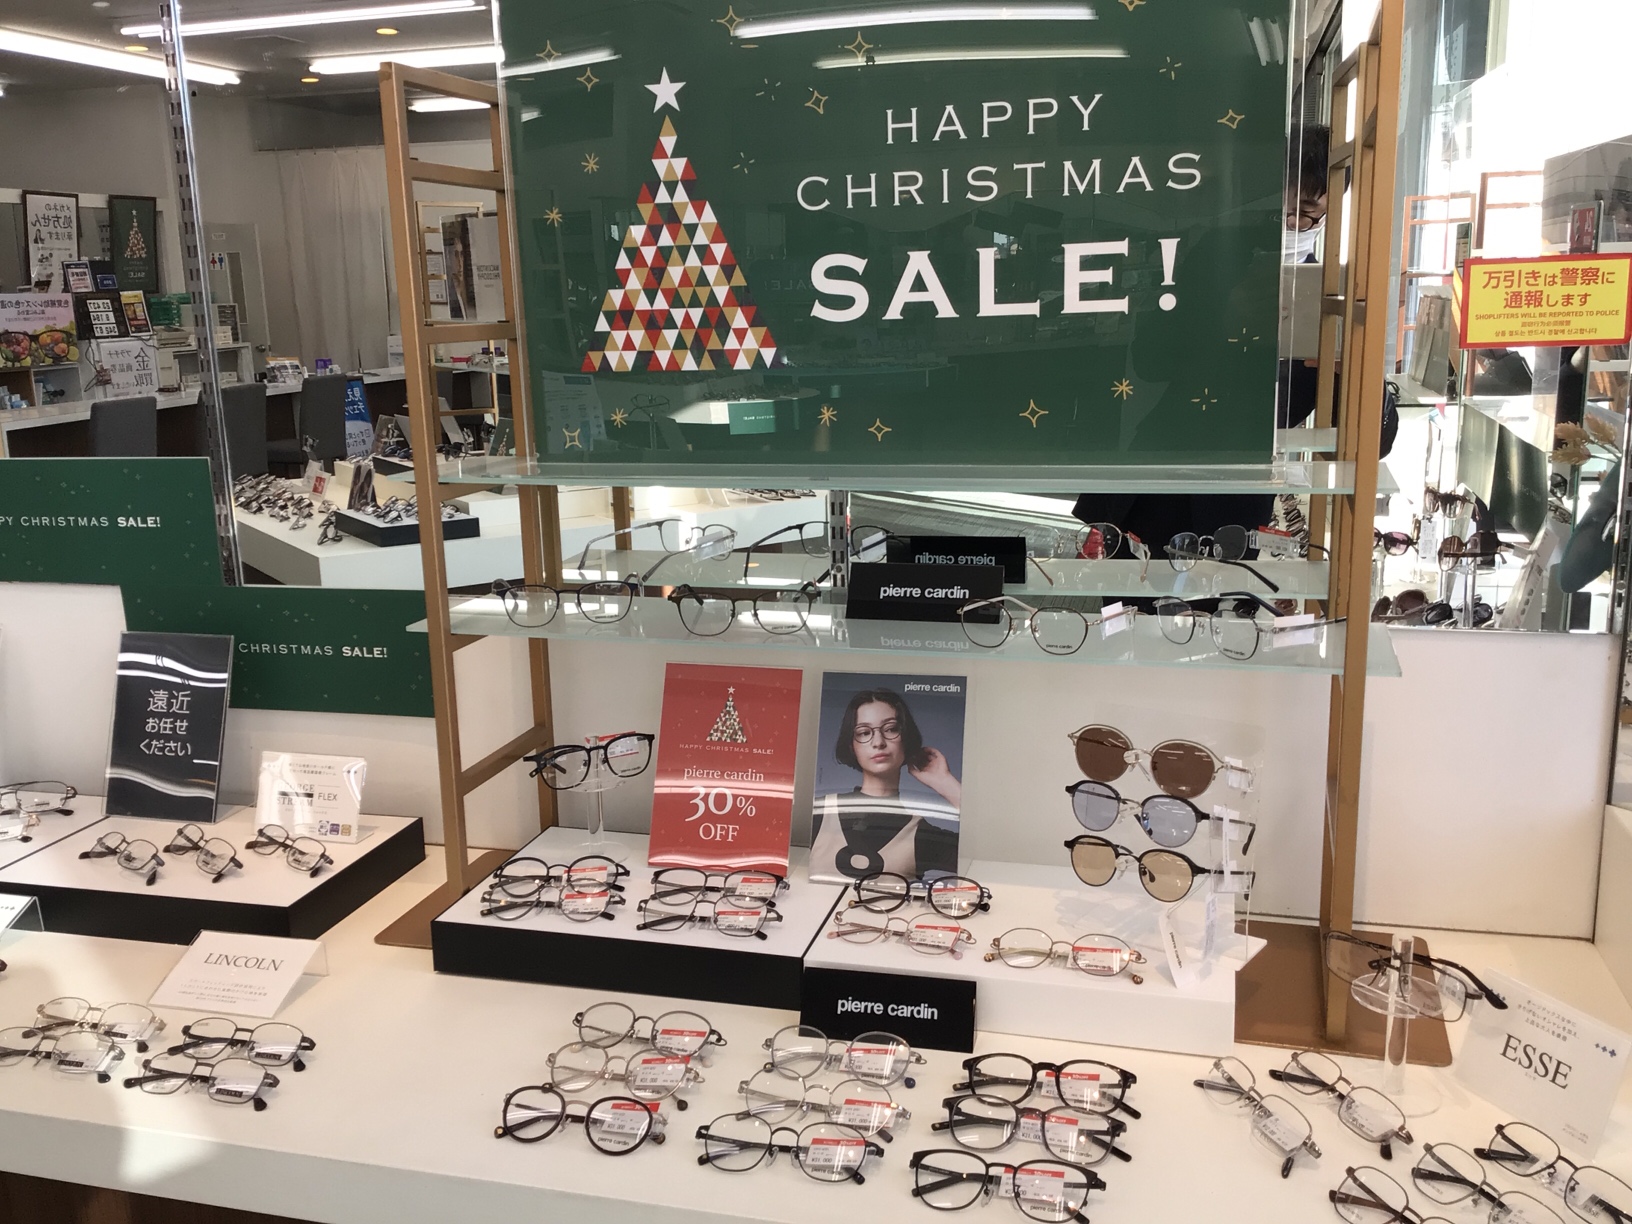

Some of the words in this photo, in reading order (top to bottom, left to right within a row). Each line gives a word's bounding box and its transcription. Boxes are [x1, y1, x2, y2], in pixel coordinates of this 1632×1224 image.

[886, 94, 1103, 144] HAPPY
[796, 153, 1202, 211] CHRISTMAS
[809, 237, 1181, 322] SALE!
[1482, 267, 1616, 289] 万引きは警察に
[1503, 290, 1592, 309] 通報します
[20, 516, 109, 527] CHRISTMAS
[117, 516, 161, 527] SALE!
[879, 583, 921, 599] pierre
[924, 584, 970, 599] cardin
[238, 643, 334, 656] CHRISTMAS
[341, 646, 388, 658] SALE!
[904, 682, 930, 693] pierre
[932, 683, 961, 693] cardin
[147, 689, 191, 714] 遠近
[145, 717, 189, 735] お任せ
[139, 738, 192, 757] ください
[705, 745, 750, 753] CHRISTMAS
[683, 765, 721, 780] pierre
[724, 768, 765, 782] cardin
[317, 793, 338, 801] FLEX
[685, 785, 756, 822] 30%
[699, 822, 740, 842] OFF
[203, 953, 284, 972] LINCOLN
[837, 996, 884, 1015] pierre
[887, 1000, 938, 1020] cardin
[1500, 1033, 1573, 1089] ESSE
[597, 1136, 613, 1144] pierre
[613, 1139, 630, 1147] cardin
[1075, 1150, 1093, 1159] cardin
[811, 1166, 826, 1175] pierre
[1583, 1204, 1601, 1219] ESSE
